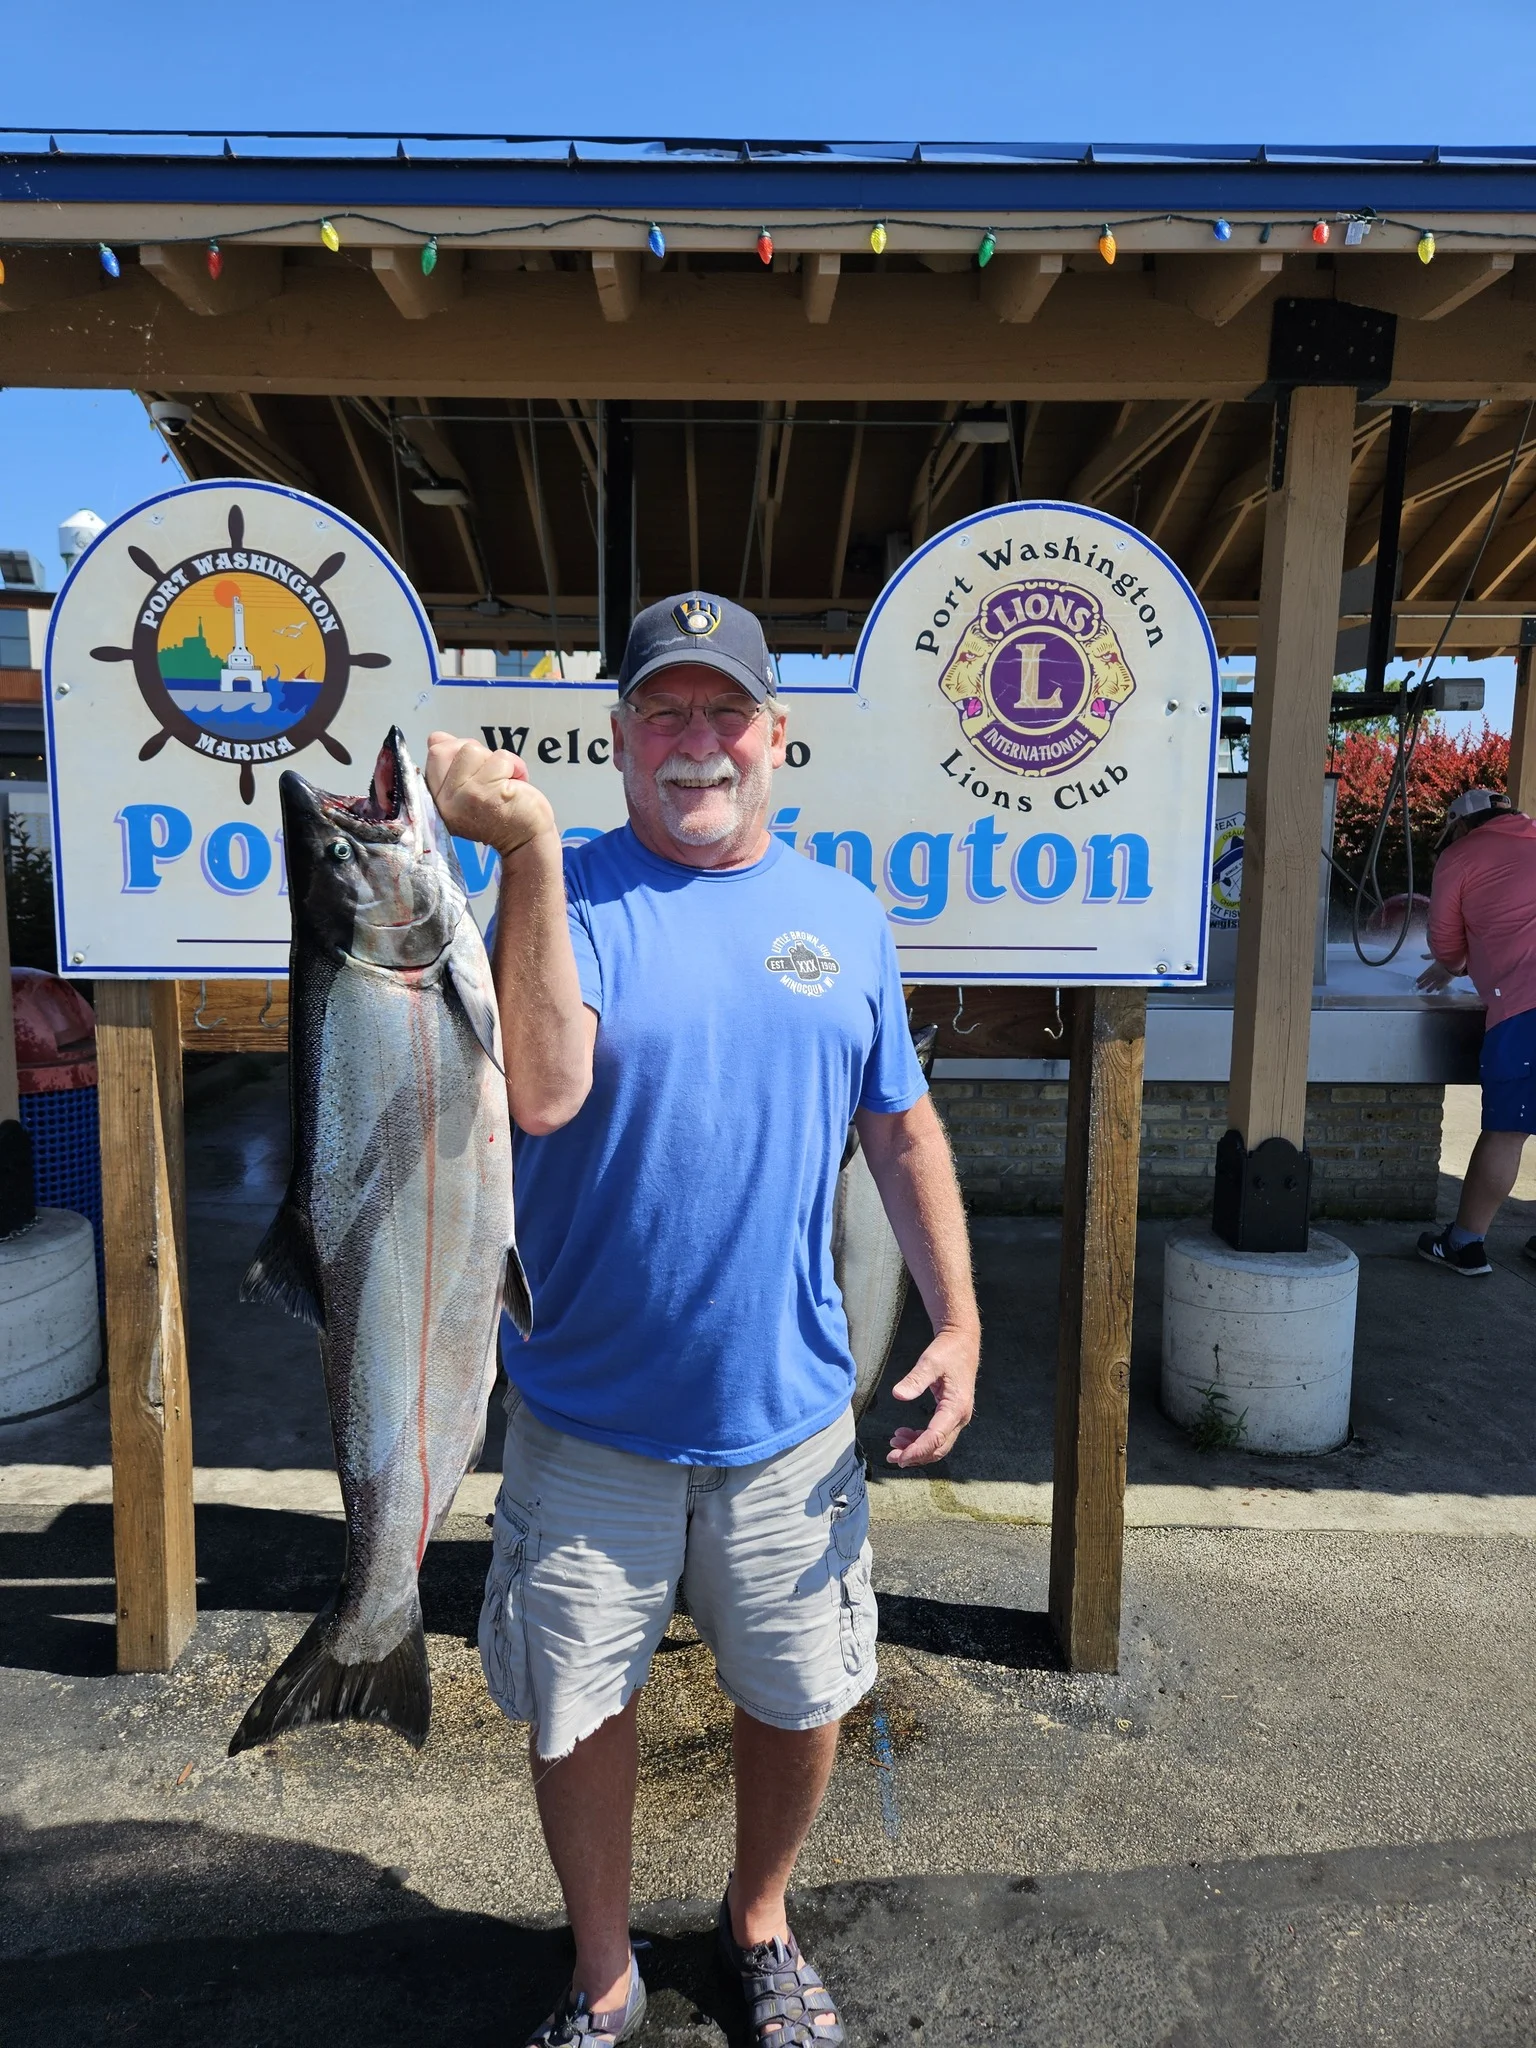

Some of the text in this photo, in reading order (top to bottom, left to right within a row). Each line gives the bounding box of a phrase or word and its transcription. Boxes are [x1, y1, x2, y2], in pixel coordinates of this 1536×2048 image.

[140, 552, 340, 634] PORT WASHINGTON
[915, 536, 1164, 656] Port Washington
[993, 593, 1091, 633] LIONS
[1013, 643, 1063, 709] L
[194, 732, 296, 761] MARINA
[481, 726, 610, 765] Welc
[983, 727, 1089, 762] INTERNATIONAL
[939, 749, 1128, 813] Lions Club
[1215, 817, 1237, 831] REAT
[115, 804, 290, 896] Po
[771, 932, 791, 953] LITTLE
[789, 930, 819, 948] BROWN
[796, 959, 819, 973] XXX
